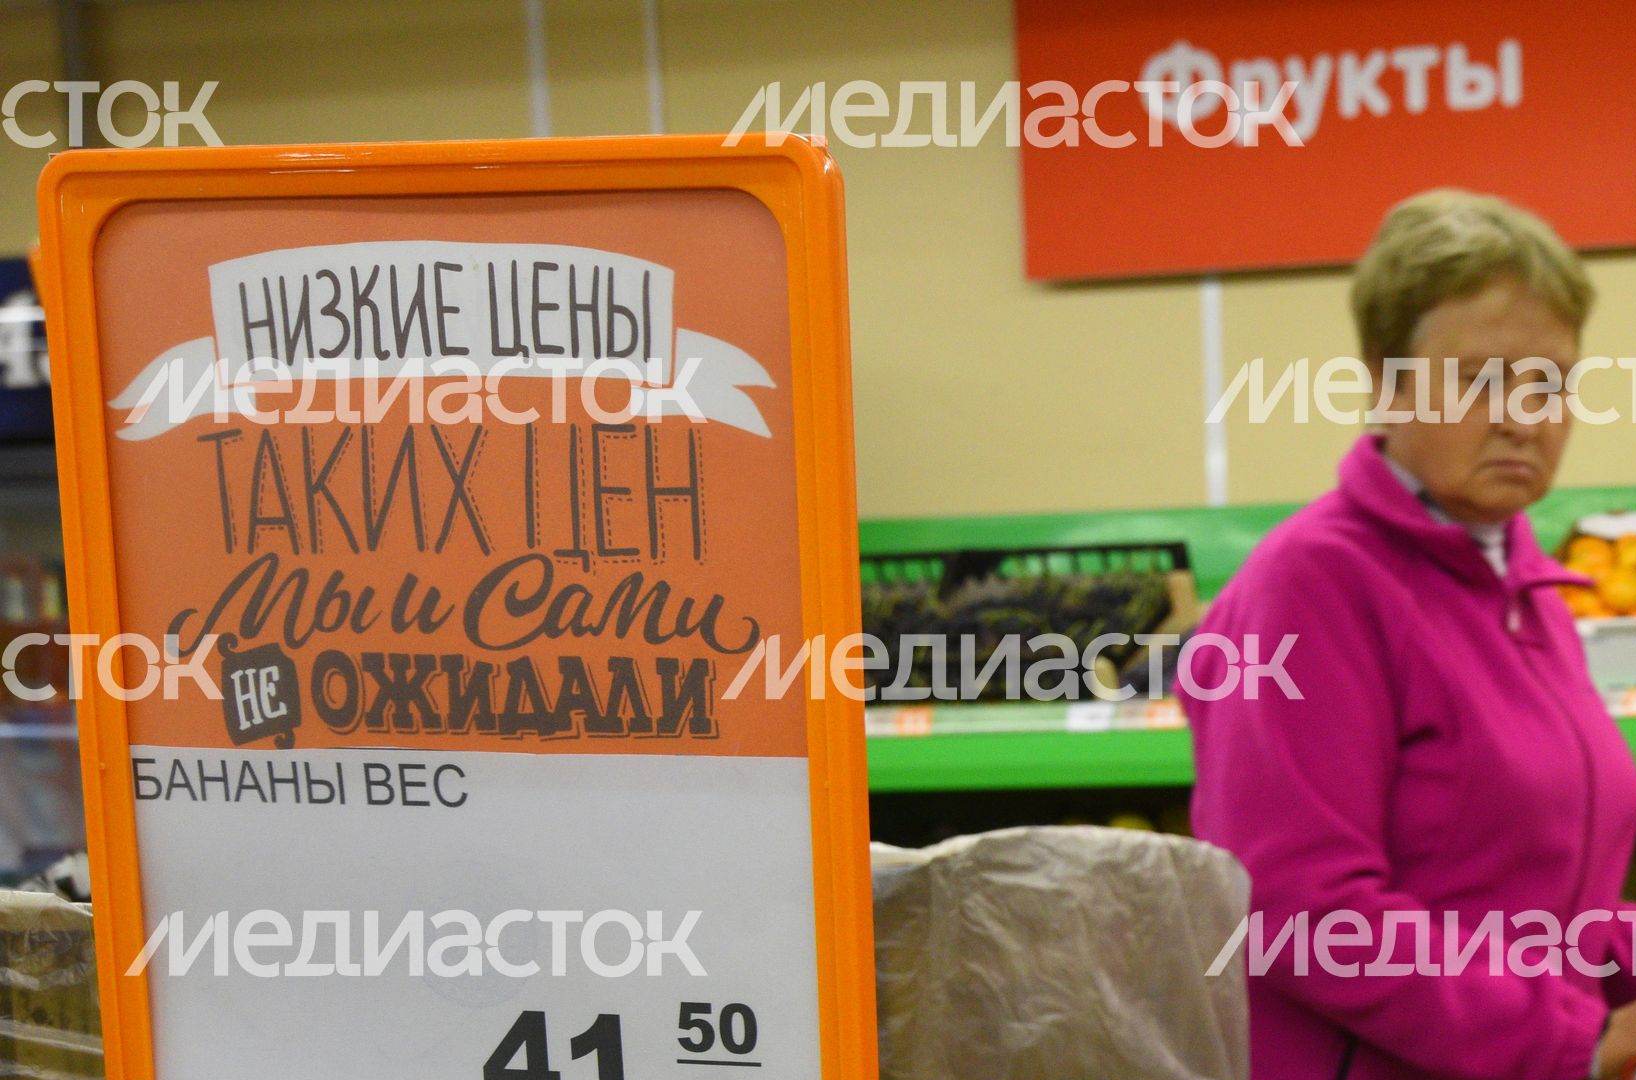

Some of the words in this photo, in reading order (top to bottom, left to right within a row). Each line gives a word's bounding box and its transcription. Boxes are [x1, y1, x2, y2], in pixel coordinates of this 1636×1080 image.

[1139, 39, 1523, 147] Фрукты
[239, 261, 470, 375] НИЗКИЕ
[488, 260, 652, 364] ЦЕНЫ
[198, 424, 496, 555] ТАКИХ
[524, 423, 707, 576] ЦЕН
[166, 553, 382, 658] Мы
[230, 666, 290, 731] НЕ
[310, 651, 720, 740] ОЖИДАЛИ
[132, 757, 346, 804] БАНАНЫ
[364, 763, 468, 808] ВЕС
[677, 1002, 757, 1054] 50
